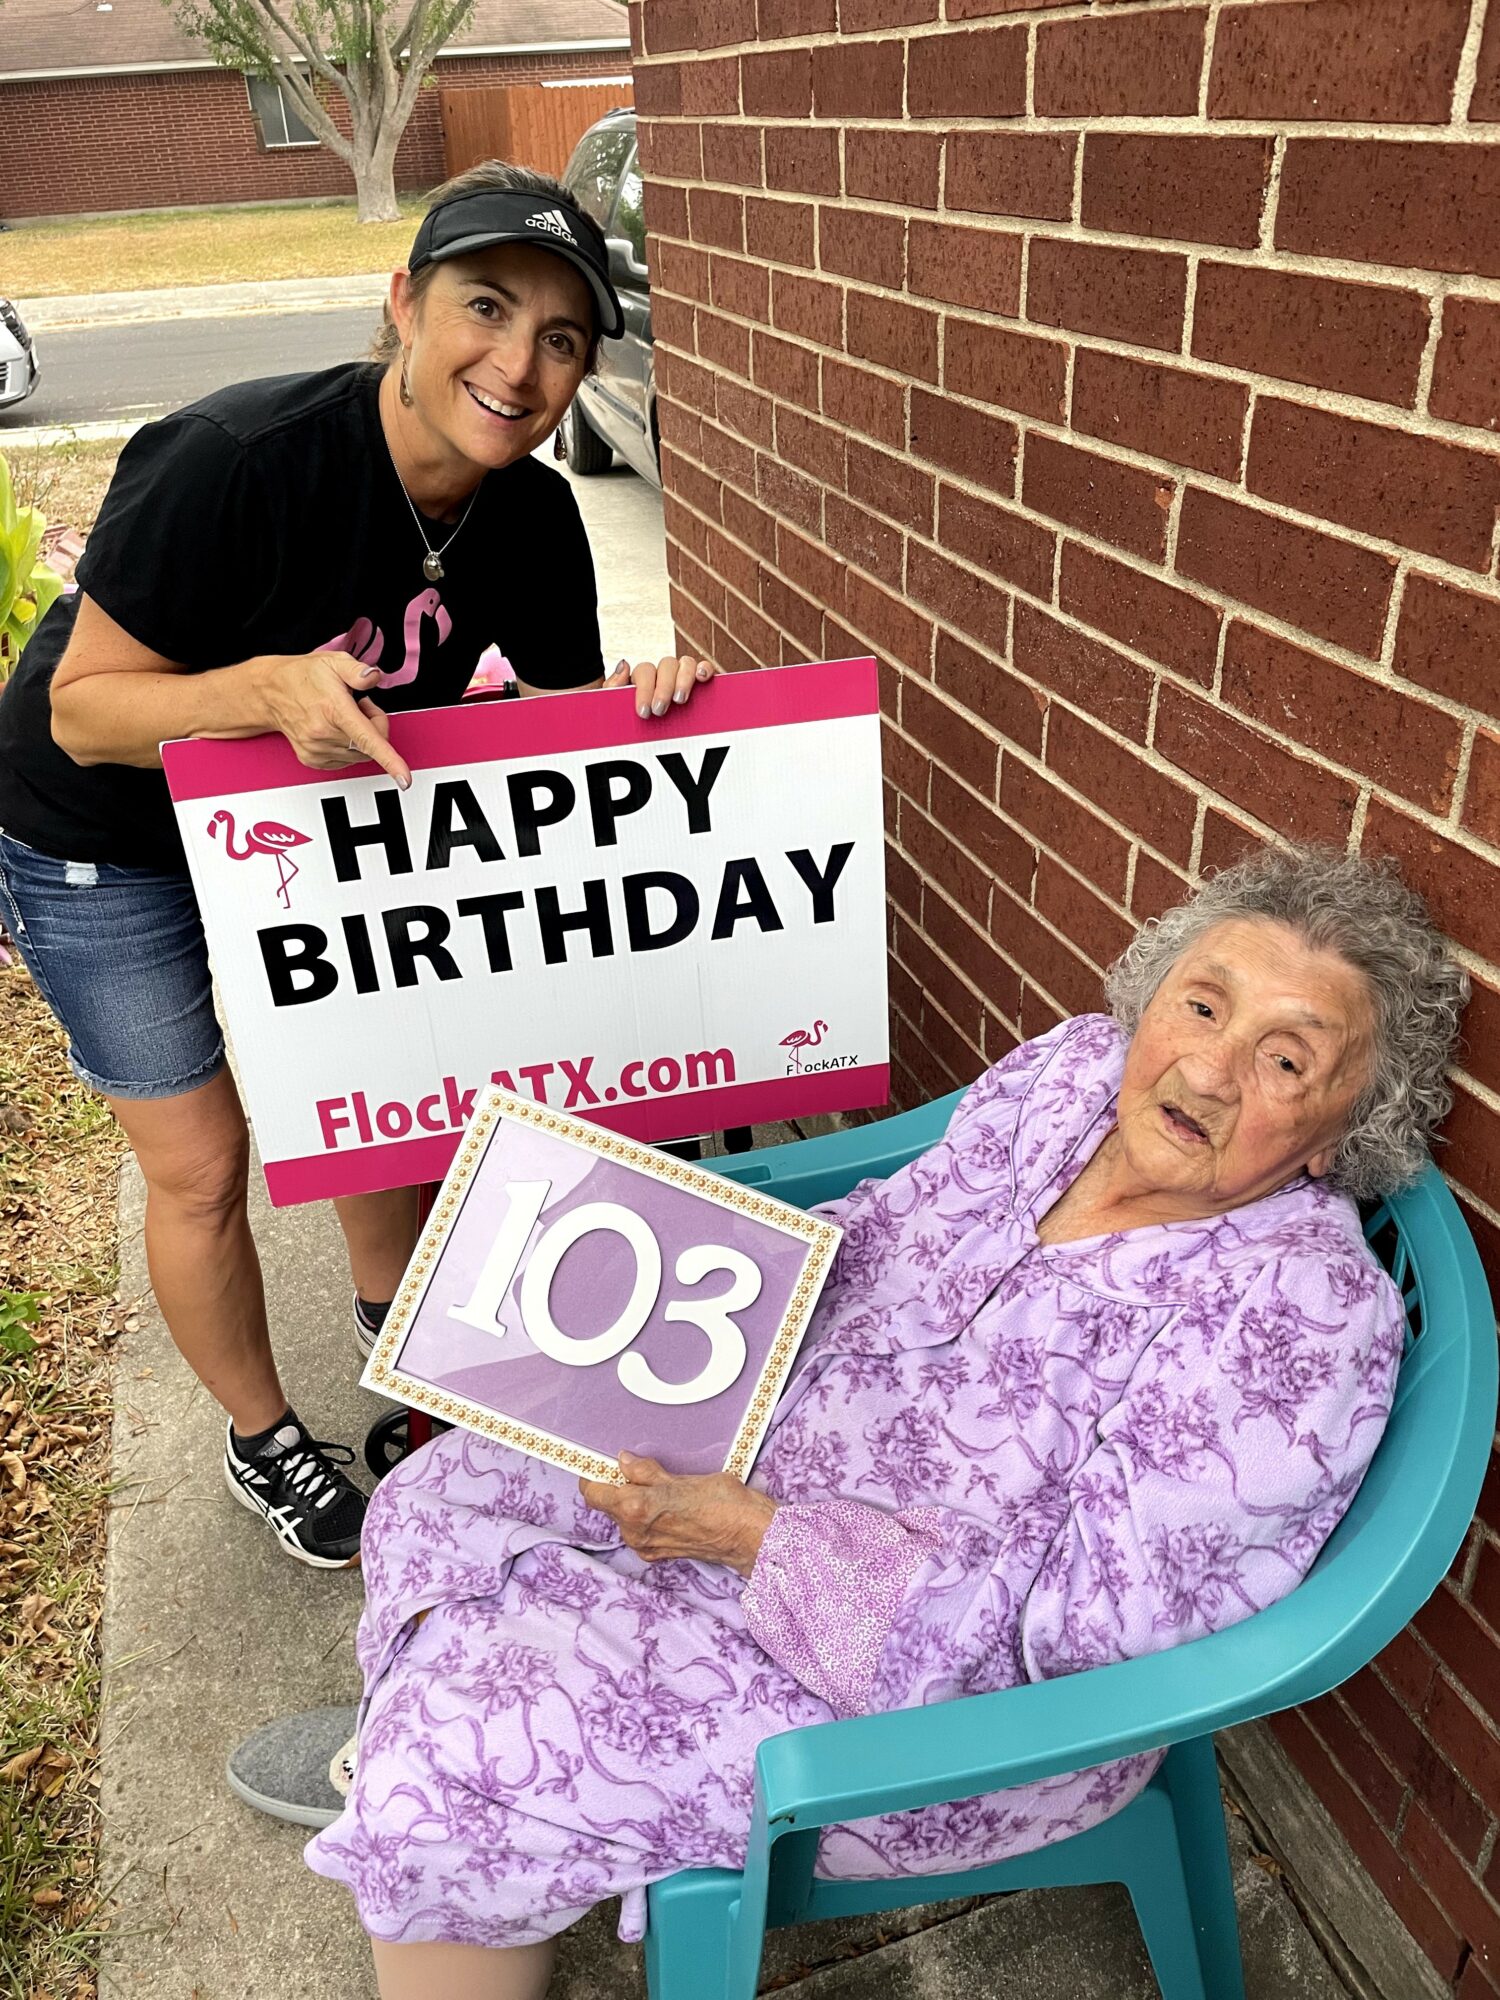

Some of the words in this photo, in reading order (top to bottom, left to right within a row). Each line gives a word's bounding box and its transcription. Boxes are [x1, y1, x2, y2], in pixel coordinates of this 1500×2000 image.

[525, 218, 578, 246] adidas
[321, 746, 731, 882] HAPPY
[257, 842, 856, 1007] BIRTHDAY
[447, 1180, 762, 1404] 103
